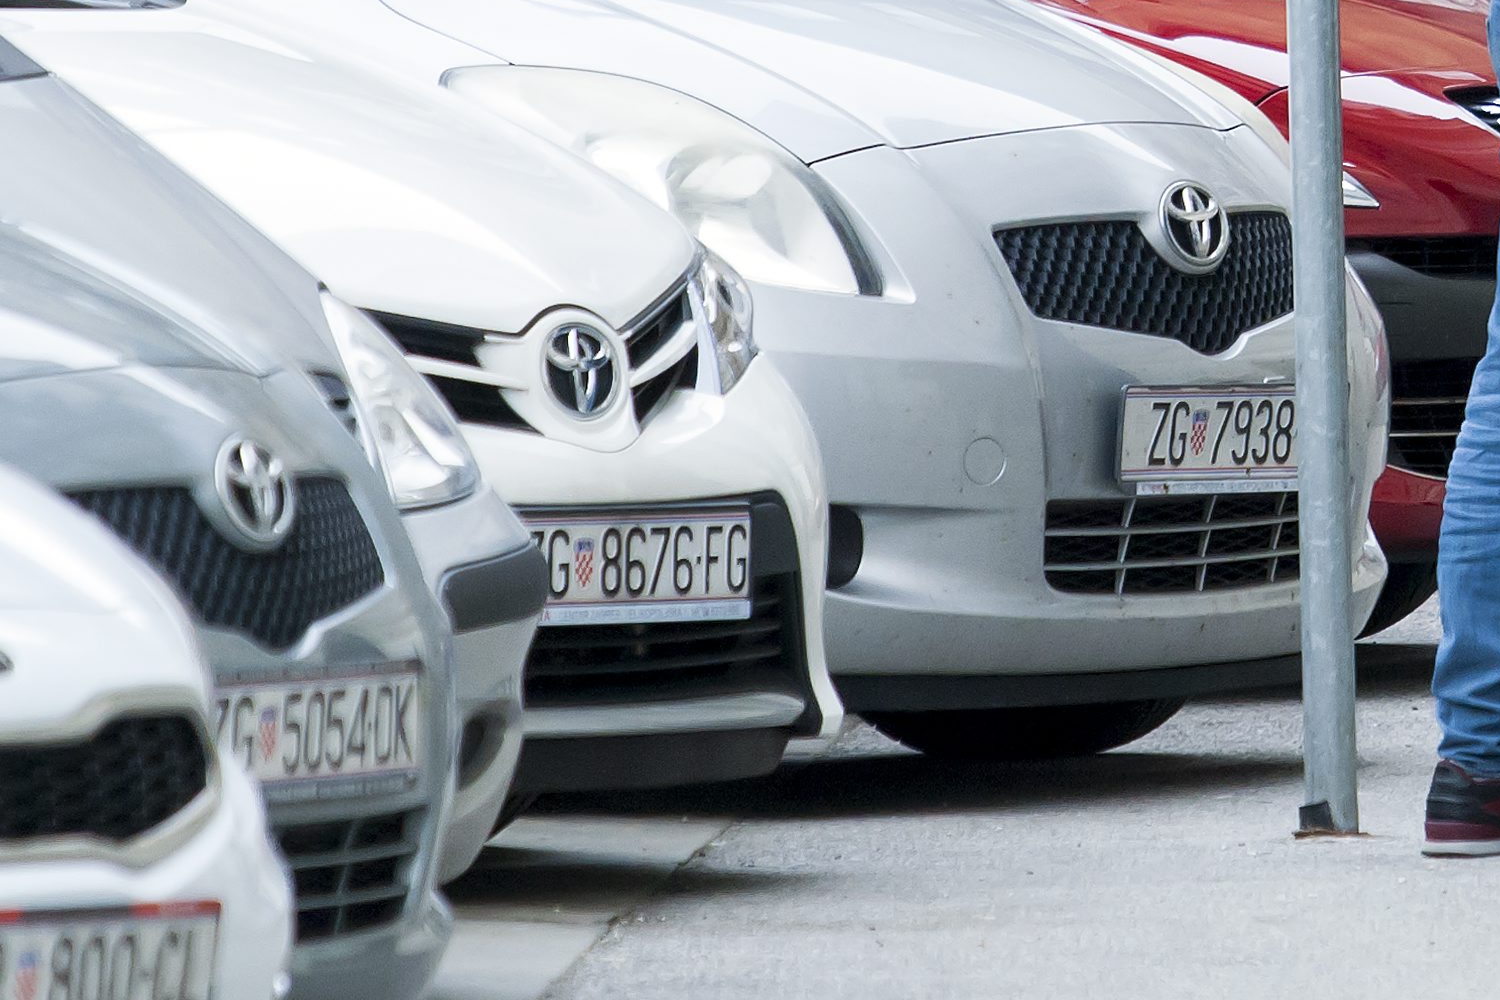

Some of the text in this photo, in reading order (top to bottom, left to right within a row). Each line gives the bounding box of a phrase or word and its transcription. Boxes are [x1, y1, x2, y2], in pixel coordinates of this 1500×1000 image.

[1148, 400, 1295, 466] ZG 7938
[531, 524, 747, 598] G 8676-FG
